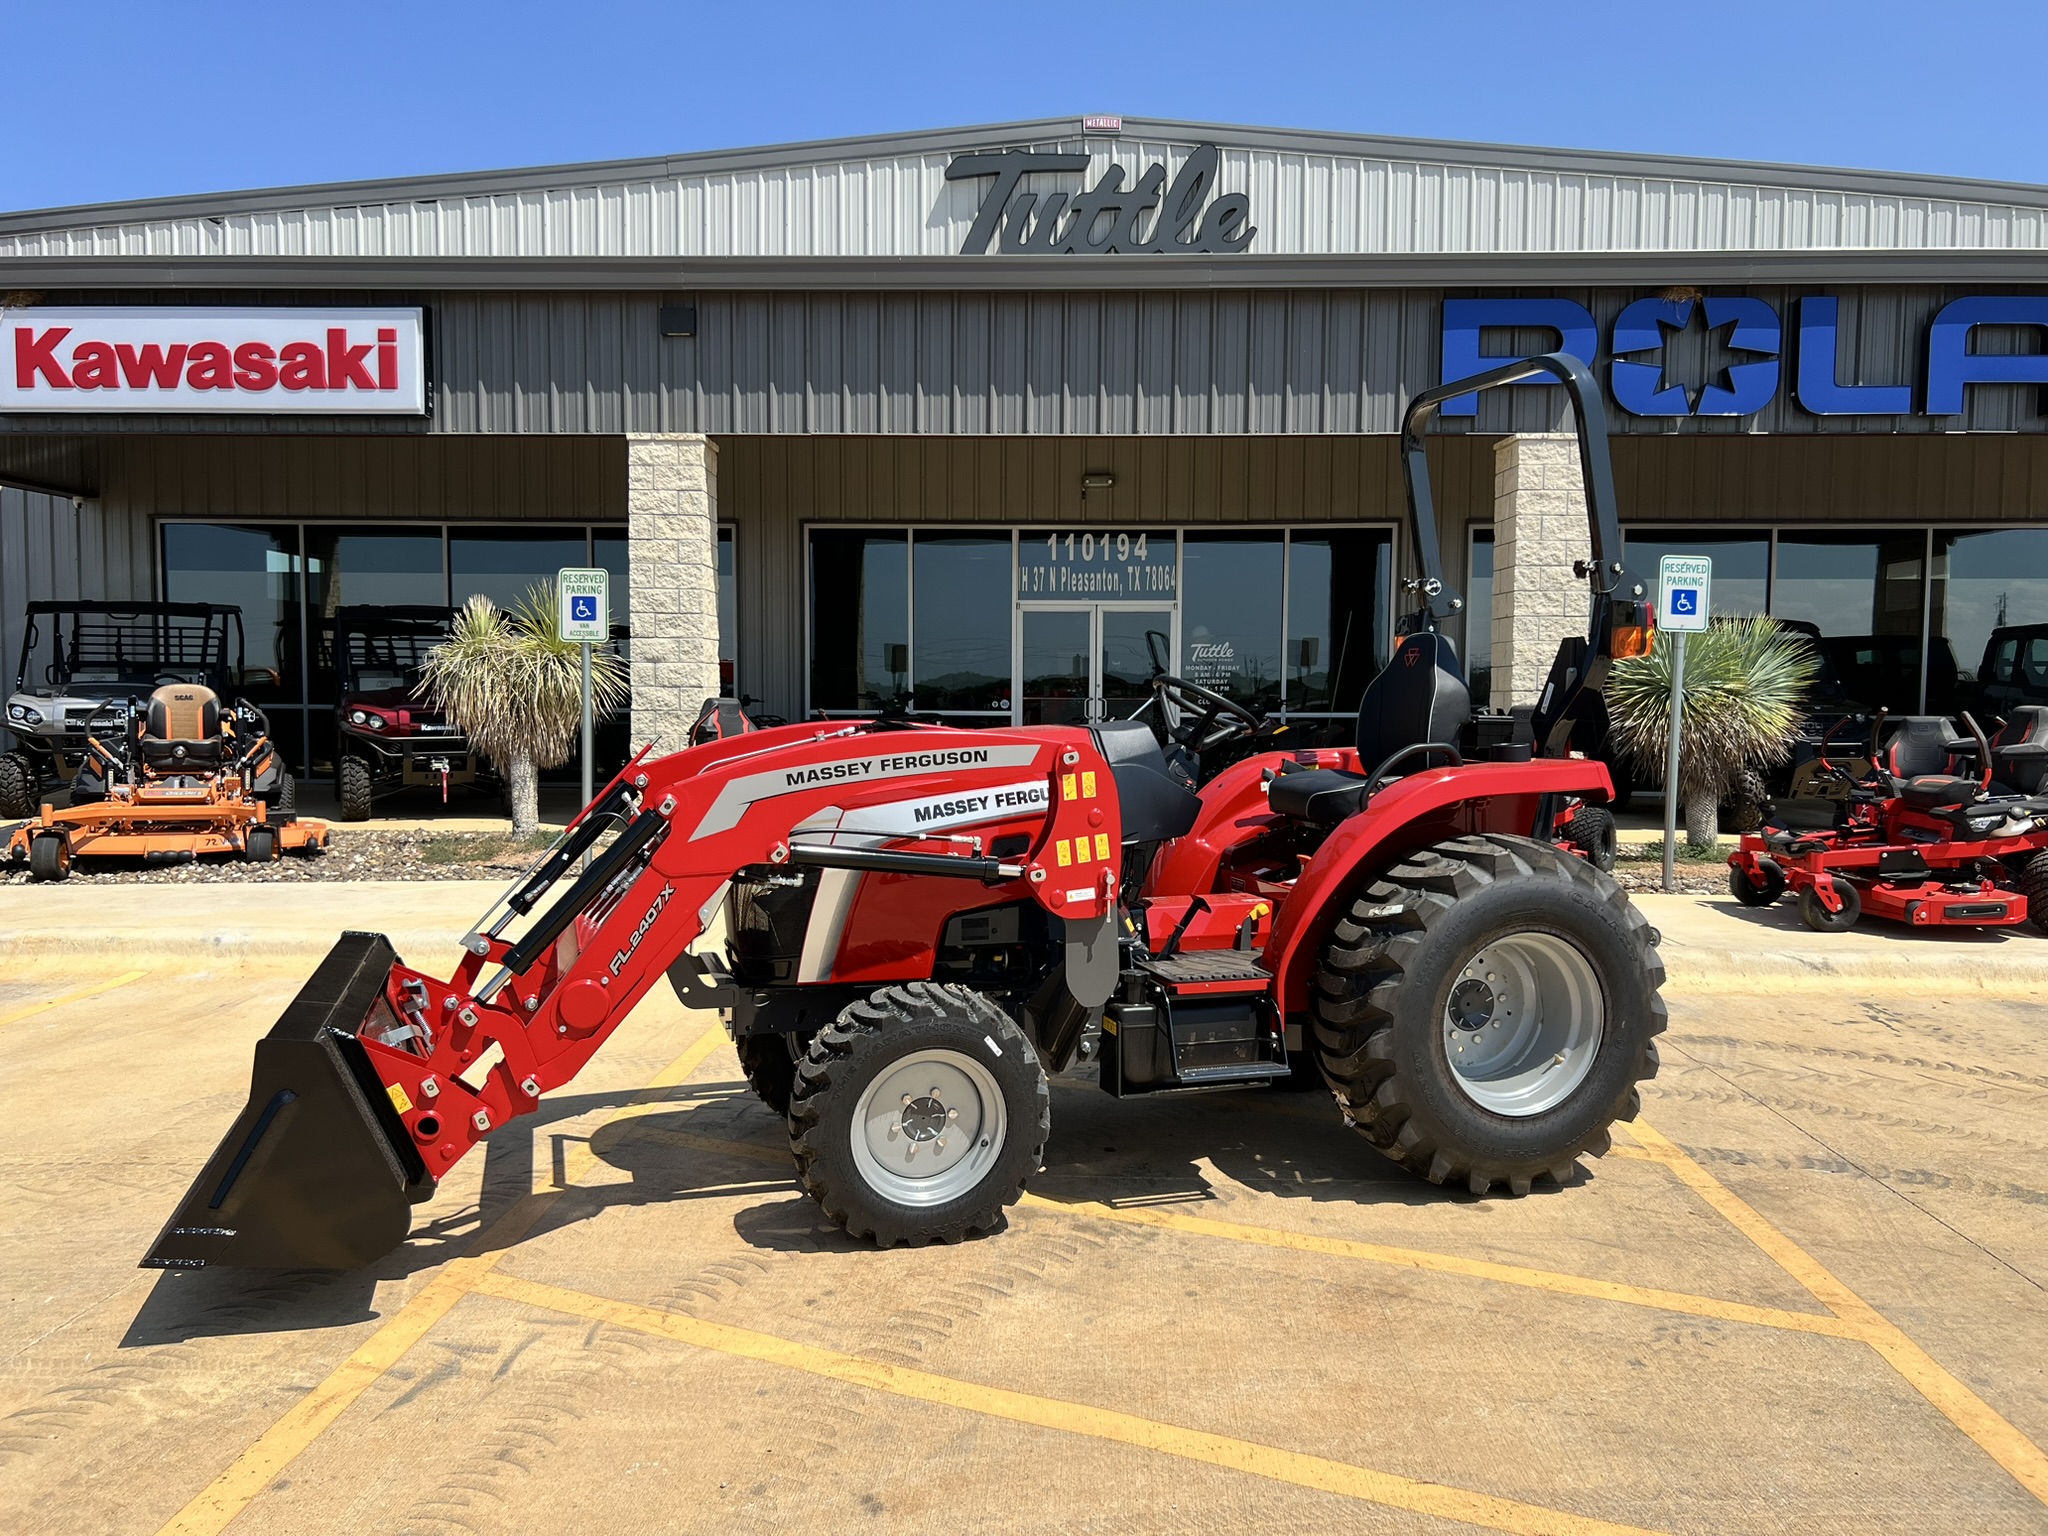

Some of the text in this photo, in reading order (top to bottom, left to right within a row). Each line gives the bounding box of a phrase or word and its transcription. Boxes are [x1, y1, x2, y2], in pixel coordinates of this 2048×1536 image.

[1086, 119, 1118, 128] METALLIC
[945, 144, 1257, 255] Tuttle
[14, 327, 400, 391] Kawasaki
[1047, 533, 1148, 562] 110194
[563, 574, 605, 584] RESERVED
[1033, 567, 1045, 592] 37
[1050, 567, 1056, 592] N
[1061, 566, 1123, 597] Pleasanton,
[1128, 566, 1141, 592] TX
[1145, 565, 1177, 592] 78064
[1664, 563, 1707, 574] RESERVED
[565, 585, 602, 594] PARKING
[1666, 576, 1704, 587] PARKING
[1190, 641, 1234, 662] Tuttle
[785, 750, 989, 787] MASSEY FERGUSON
[914, 786, 1050, 823] MASSEY FERGU
[205, 838, 218, 847] 72
[608, 880, 677, 977] FL.2407X
